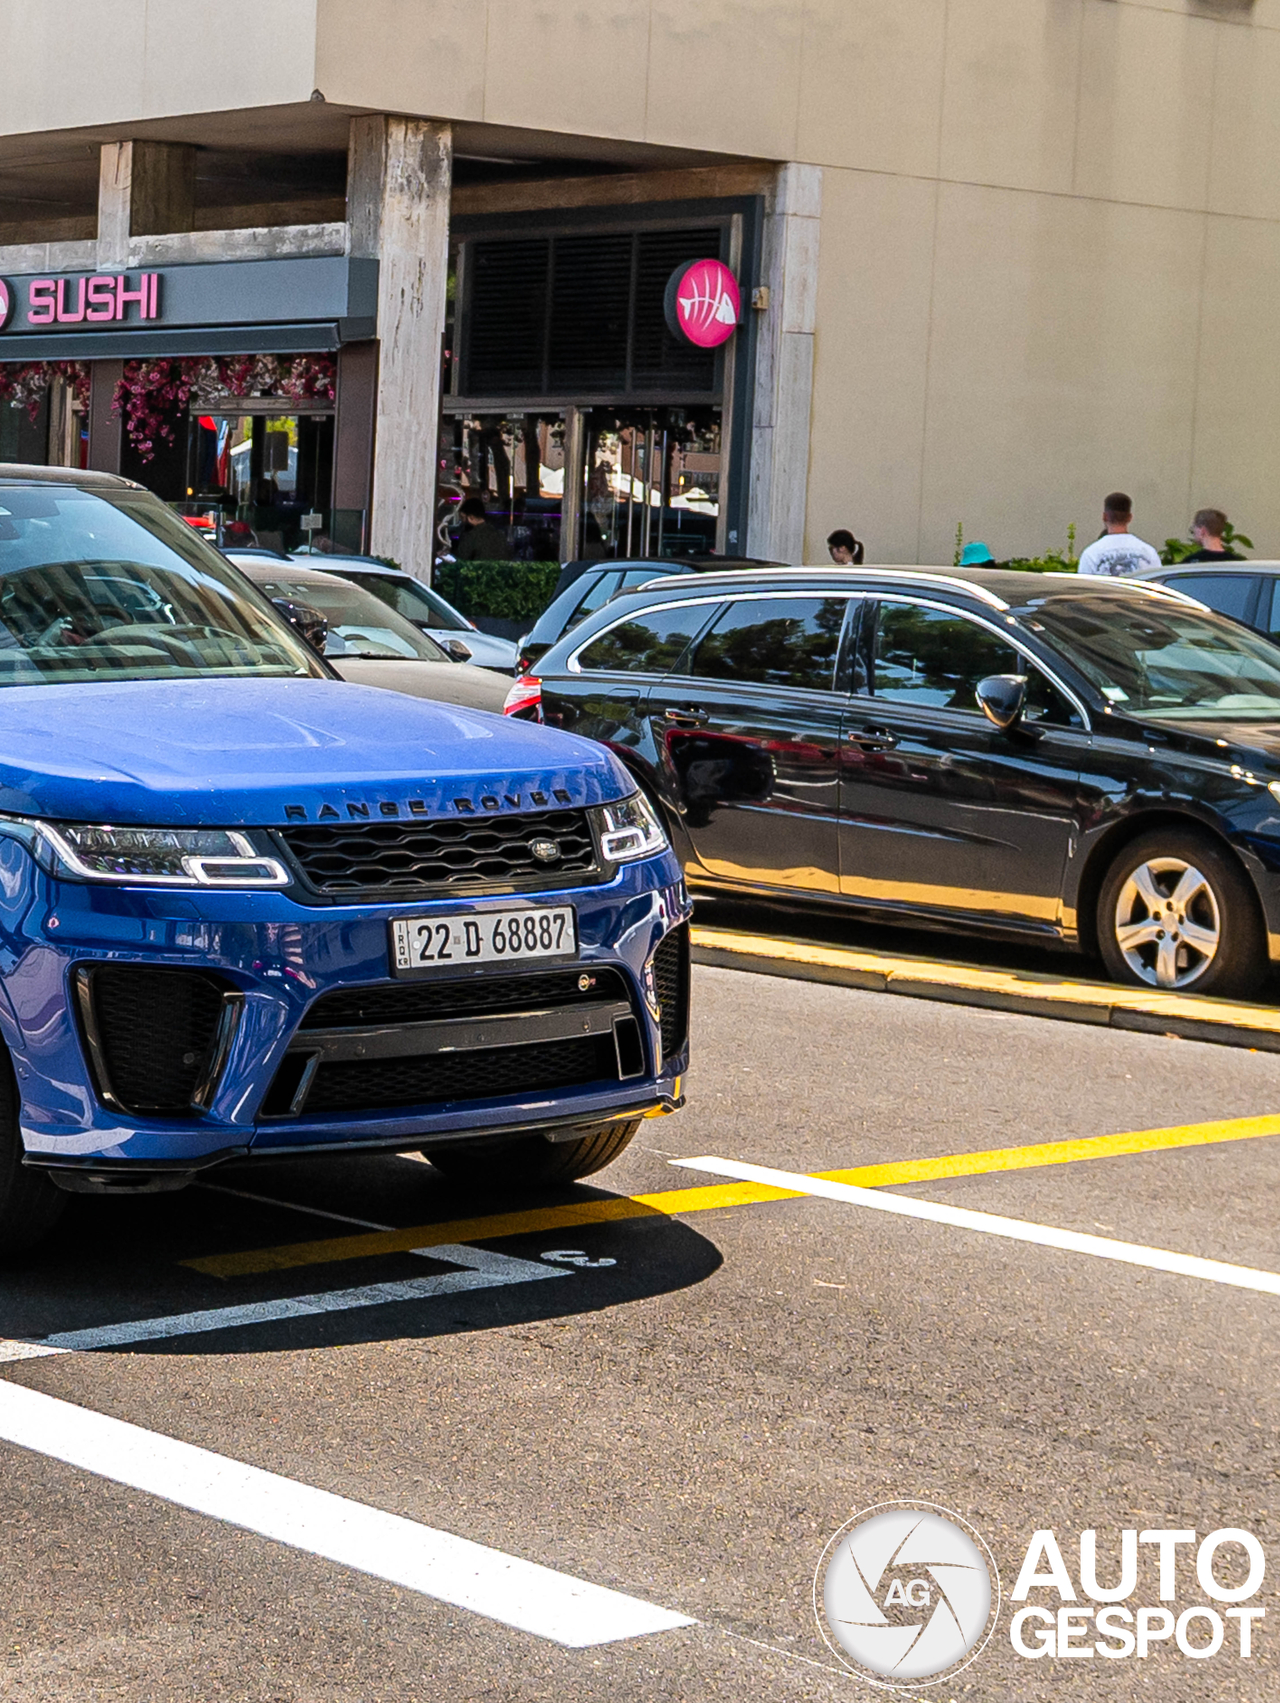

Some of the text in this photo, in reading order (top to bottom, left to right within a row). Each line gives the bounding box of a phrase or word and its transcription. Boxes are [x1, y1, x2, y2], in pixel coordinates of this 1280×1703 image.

[27, 273, 159, 324] SUSHI
[284, 788, 574, 822] RANGE ROVER
[417, 913, 567, 961] 22 D 68887
